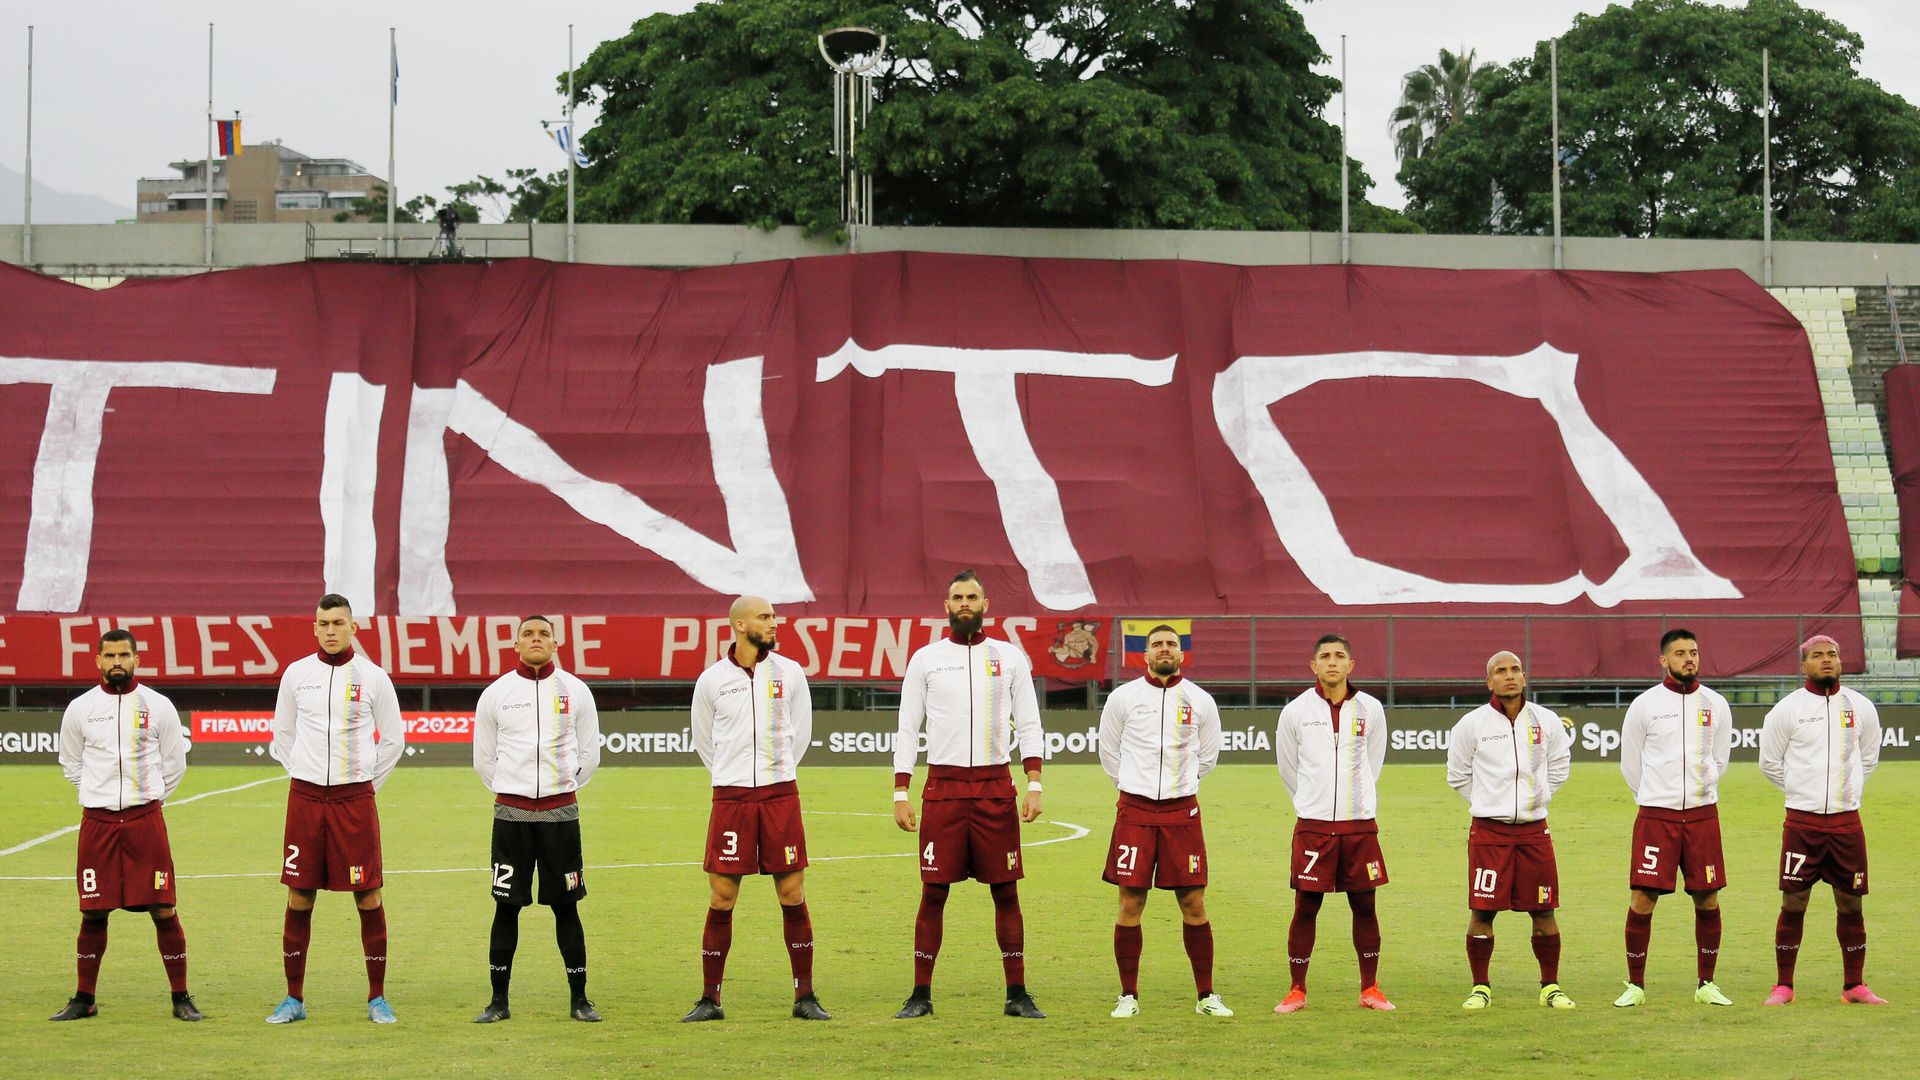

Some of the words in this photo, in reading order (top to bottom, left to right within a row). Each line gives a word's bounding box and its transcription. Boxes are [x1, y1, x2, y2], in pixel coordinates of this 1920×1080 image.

[59, 616, 279, 677] FELES
[660, 616, 1038, 678] PRSENTS
[201, 719, 239, 733] FIFA
[1880, 727, 1910, 747] AL
[722, 831, 738, 855] 3
[923, 842, 935, 865] 4
[285, 844, 300, 870] 2
[1117, 844, 1138, 870] 21
[1303, 850, 1319, 873] 7
[1642, 845, 1660, 870] 5
[1784, 851, 1806, 875] 17
[82, 868, 97, 892] 8
[493, 862, 514, 889] 12
[1474, 867, 1497, 892] 10
